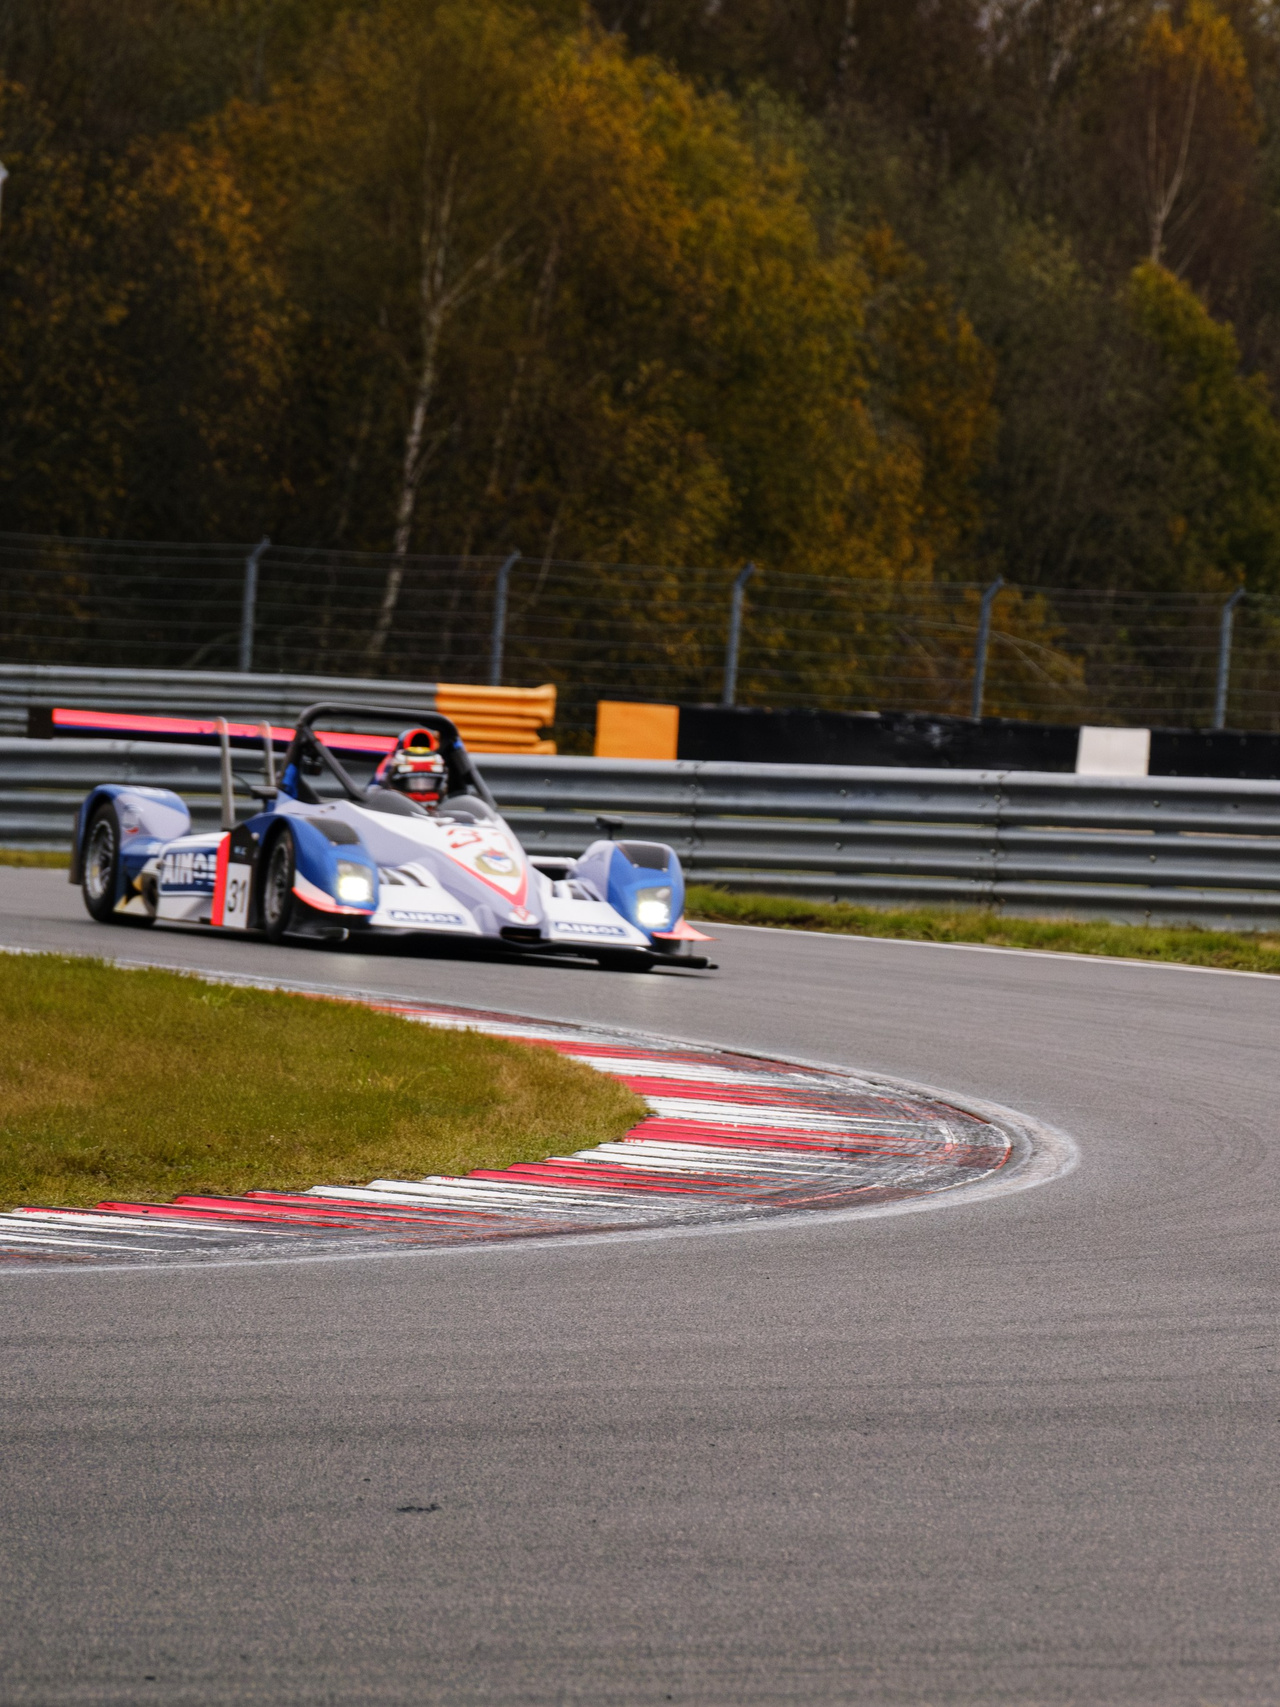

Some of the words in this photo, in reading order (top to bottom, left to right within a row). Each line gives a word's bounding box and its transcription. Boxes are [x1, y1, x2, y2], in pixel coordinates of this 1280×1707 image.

[227, 879, 247, 913] 31
[393, 910, 461, 924] AIMOL
[557, 922, 626, 936] AIMOL
